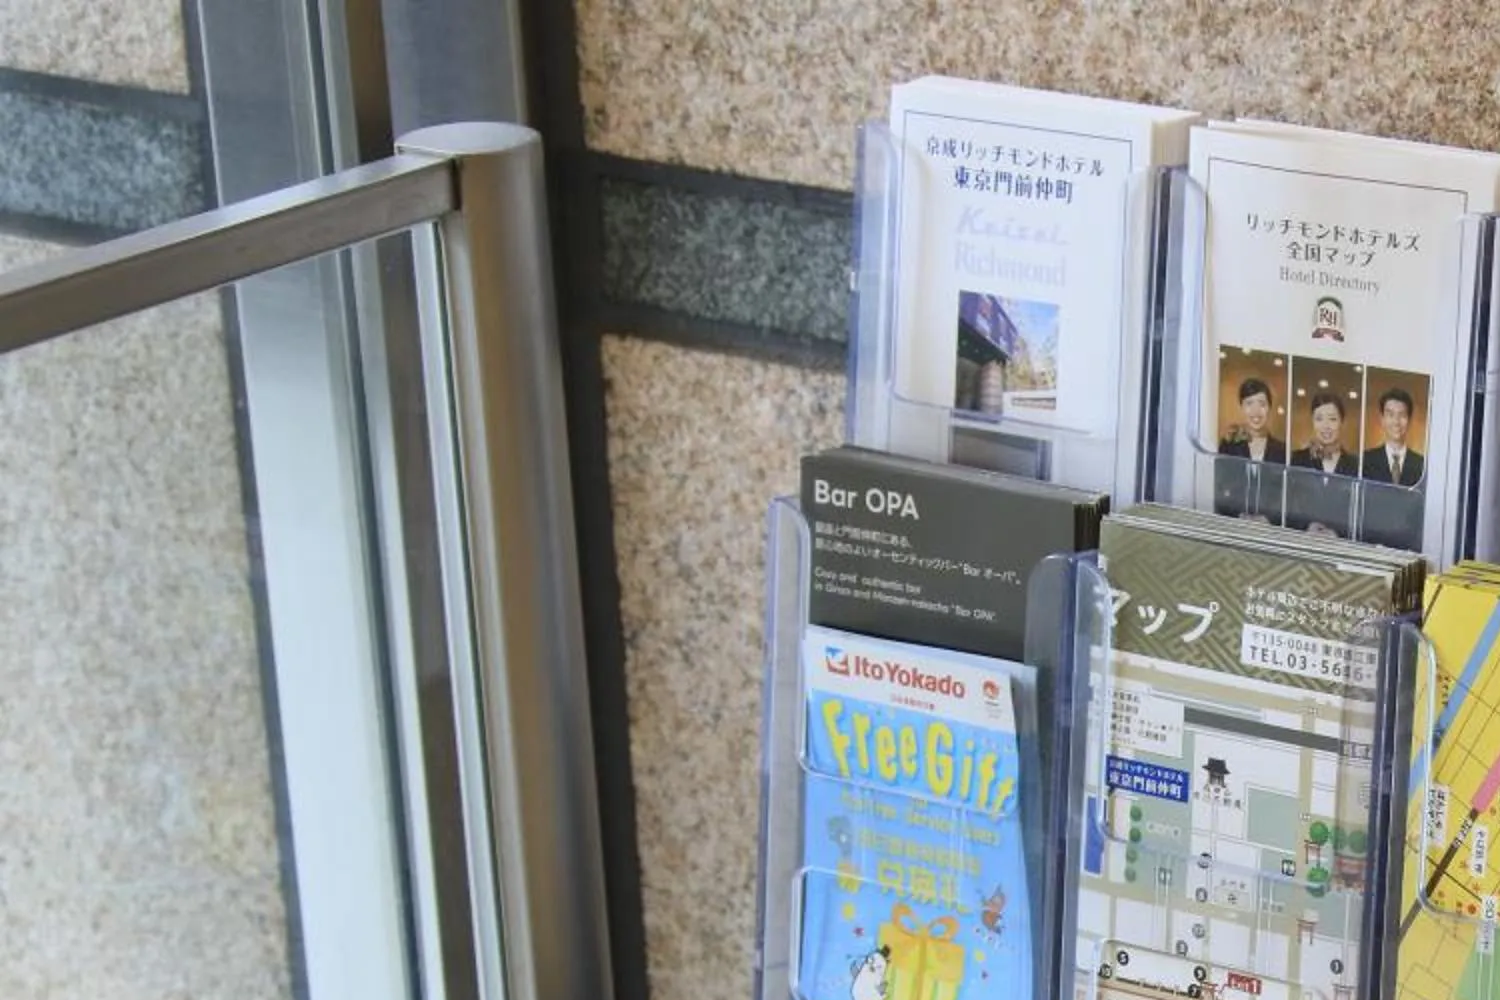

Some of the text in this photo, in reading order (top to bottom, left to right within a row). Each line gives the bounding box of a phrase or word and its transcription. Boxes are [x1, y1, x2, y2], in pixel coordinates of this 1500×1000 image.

[926, 135, 1104, 176] 京成リッチモンドホテル
[954, 167, 1073, 204] 東京門前仲町
[1247, 213, 1419, 252] リッチモンドホテルズ
[1287, 241, 1376, 267] 全国マップ
[1279, 266, 1380, 295] Hotel Directory
[814, 479, 920, 520] Bar OPA
[854, 654, 966, 698] ItoYokado
